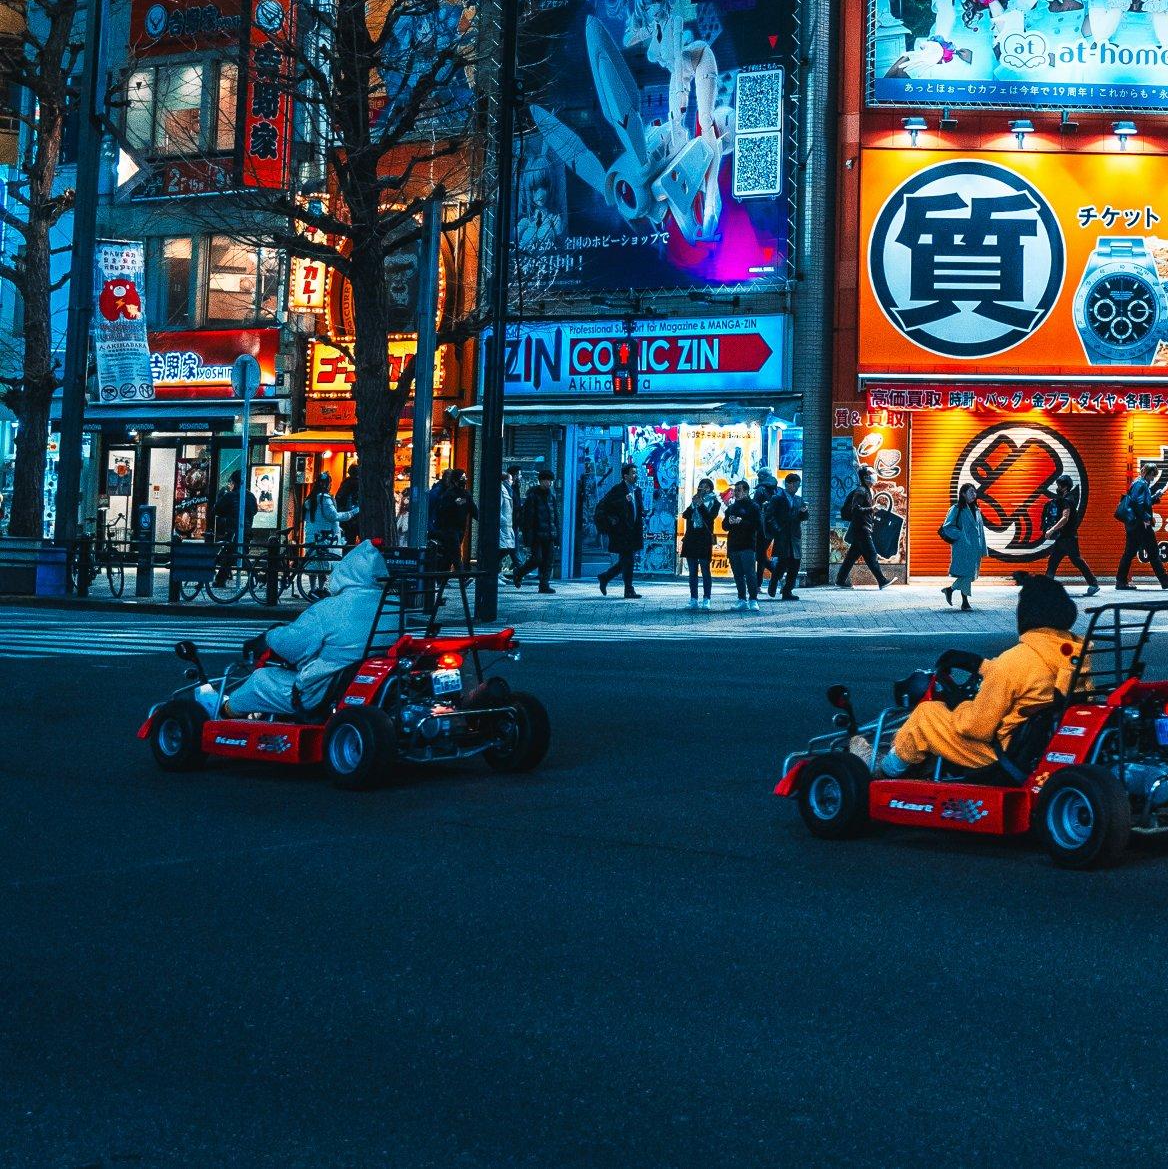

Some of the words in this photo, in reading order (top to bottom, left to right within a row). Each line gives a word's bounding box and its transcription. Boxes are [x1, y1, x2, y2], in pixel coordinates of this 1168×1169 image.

[1077, 205, 1161, 230] チケット
[893, 191, 1042, 332] 質
[303, 263, 320, 306] カレー
[660, 320, 699, 332] Magazine
[572, 339, 670, 373] COIC
[677, 338, 720, 371] ZIN
